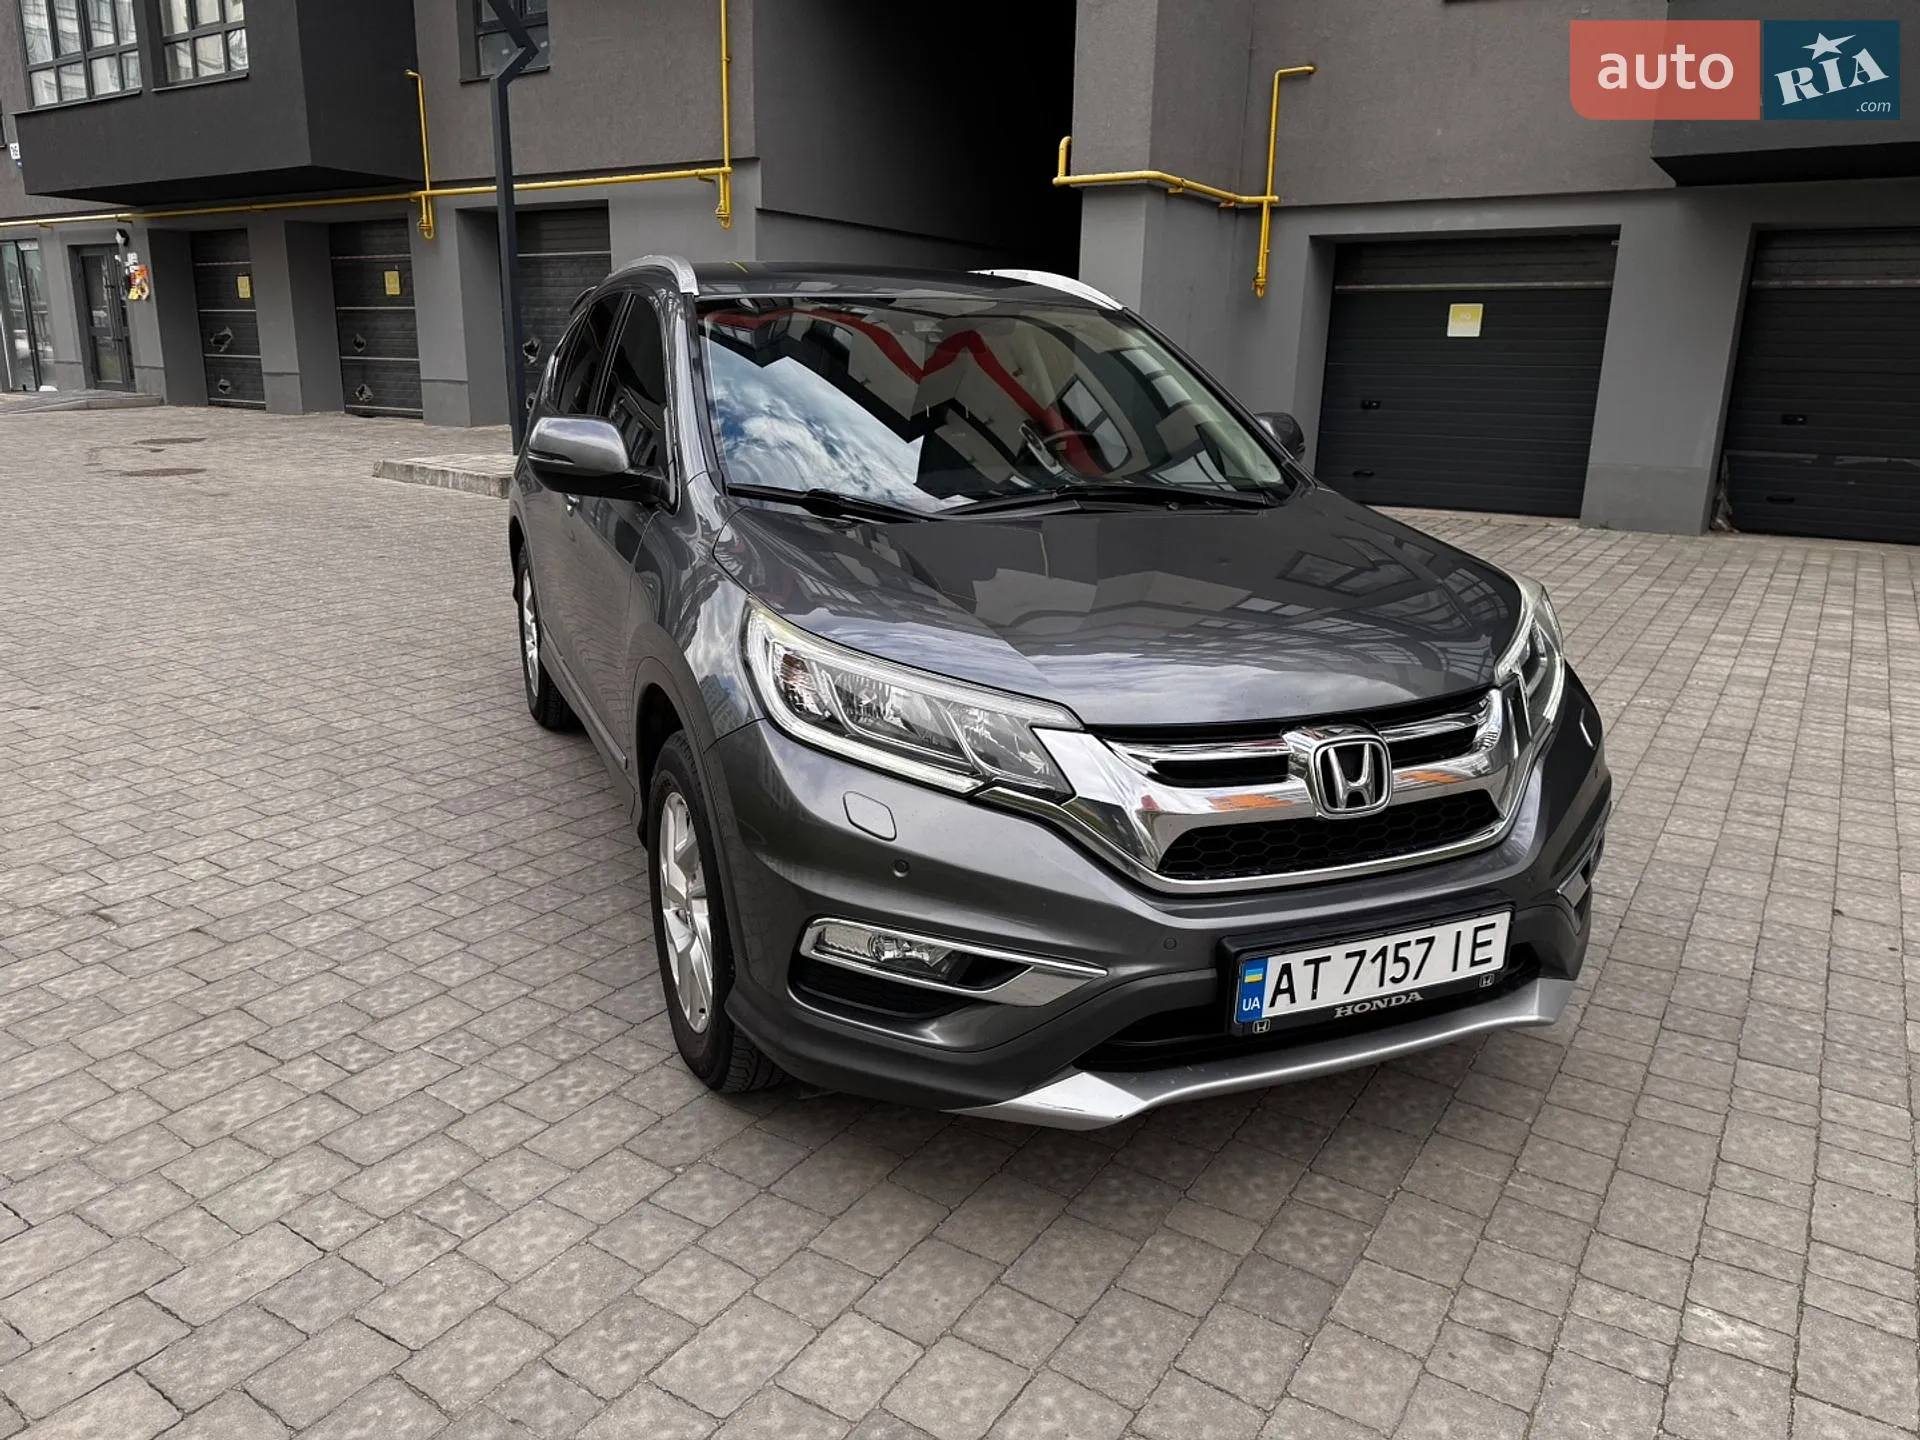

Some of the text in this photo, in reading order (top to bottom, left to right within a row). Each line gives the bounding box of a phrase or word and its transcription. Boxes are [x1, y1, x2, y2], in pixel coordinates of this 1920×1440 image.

[1269, 922, 1497, 1008] AT 7157 IE
[1242, 997, 1261, 1012] UA
[1333, 990, 1424, 1019] HONDA
